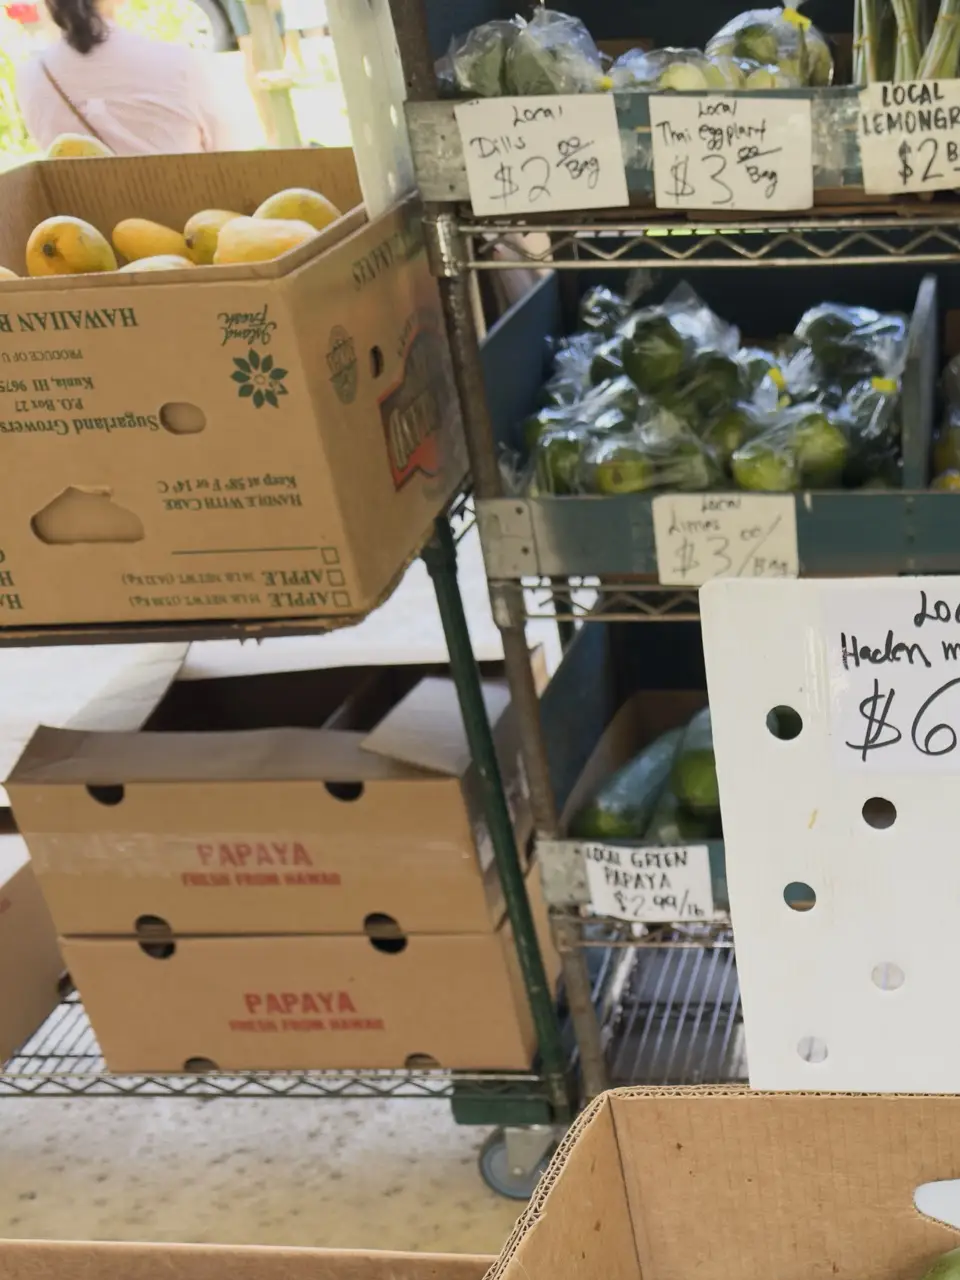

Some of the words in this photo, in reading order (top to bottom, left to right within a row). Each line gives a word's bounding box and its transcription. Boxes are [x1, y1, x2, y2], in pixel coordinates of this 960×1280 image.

[881, 82, 944, 106] LOCAL
[656, 121, 692, 145] Thai
[470, 136, 526, 159] Dills
[898, 138, 944, 185] $2
[16, 307, 139, 332] HAWAIIAN
[221, 322, 277, 347] Island
[11, 351, 28, 363] OF
[28, 348, 84, 362] PRODUCE
[32, 378, 50, 393] HI
[50, 376, 95, 391] Kunia,
[14, 400, 29, 413] 27
[30, 398, 56, 412] Box
[57, 397, 84, 411] P.O.
[71, 411, 160, 435] Sugarland
[263, 473, 298, 489] Keep
[162, 498, 202, 512] CARE
[245, 493, 303, 508] HANDLE
[260, 569, 324, 587] APPLE
[267, 591, 330, 608] APPLE
[841, 630, 931, 670] Haden
[196, 841, 313, 867] PAPAYA
[630, 850, 688, 868] GREEN
[603, 866, 672, 889] PAPAYA
[243, 991, 357, 1014] PAPAYA
